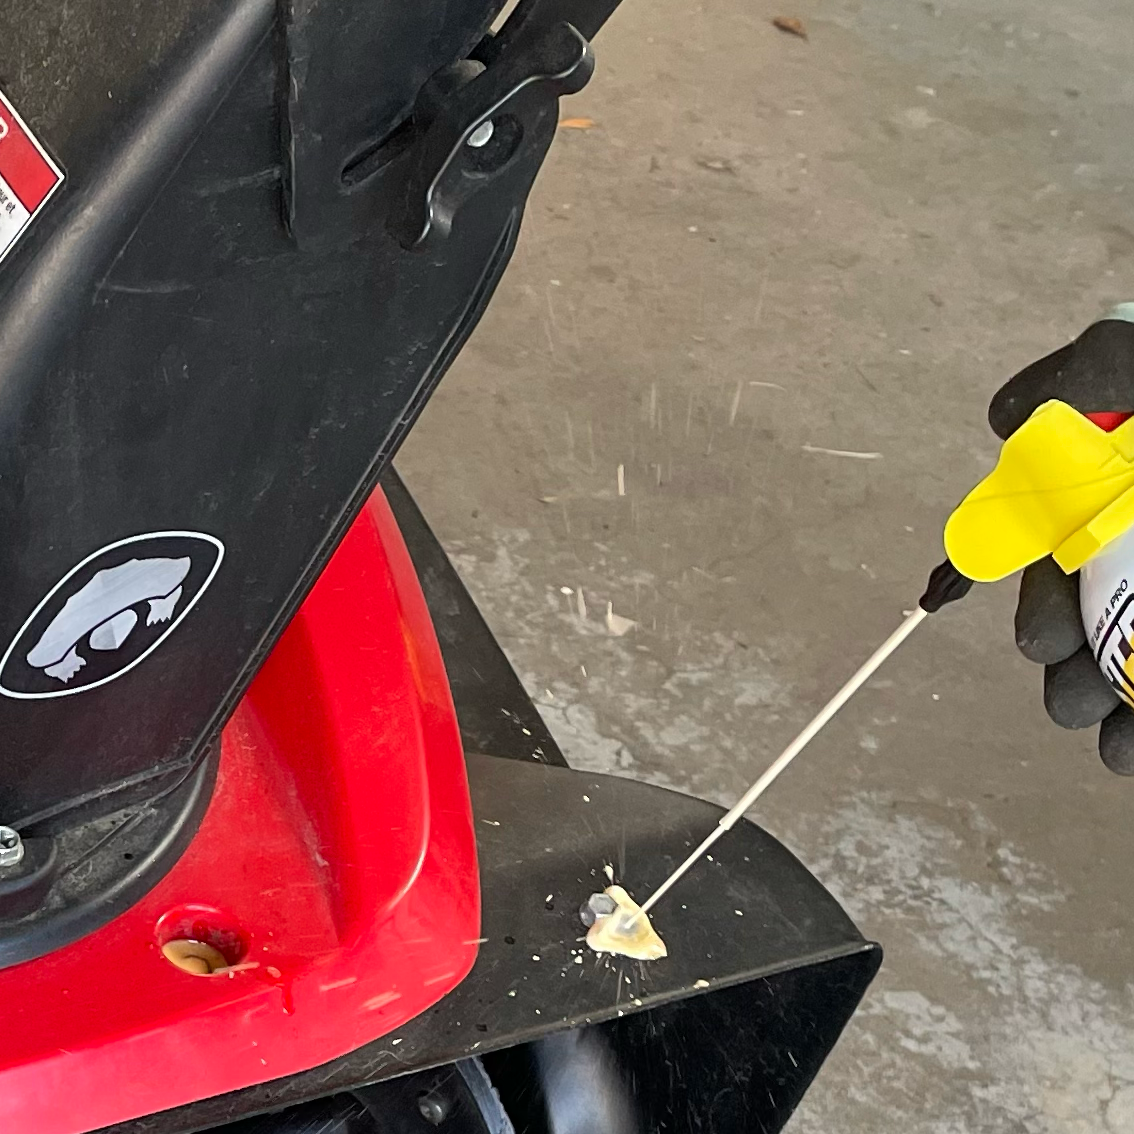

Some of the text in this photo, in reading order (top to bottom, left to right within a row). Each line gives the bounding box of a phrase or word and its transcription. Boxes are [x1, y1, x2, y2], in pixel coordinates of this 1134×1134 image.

[5, 201, 16, 216] et
[1105, 606, 1112, 620] A
[1110, 578, 1128, 609] PRO
